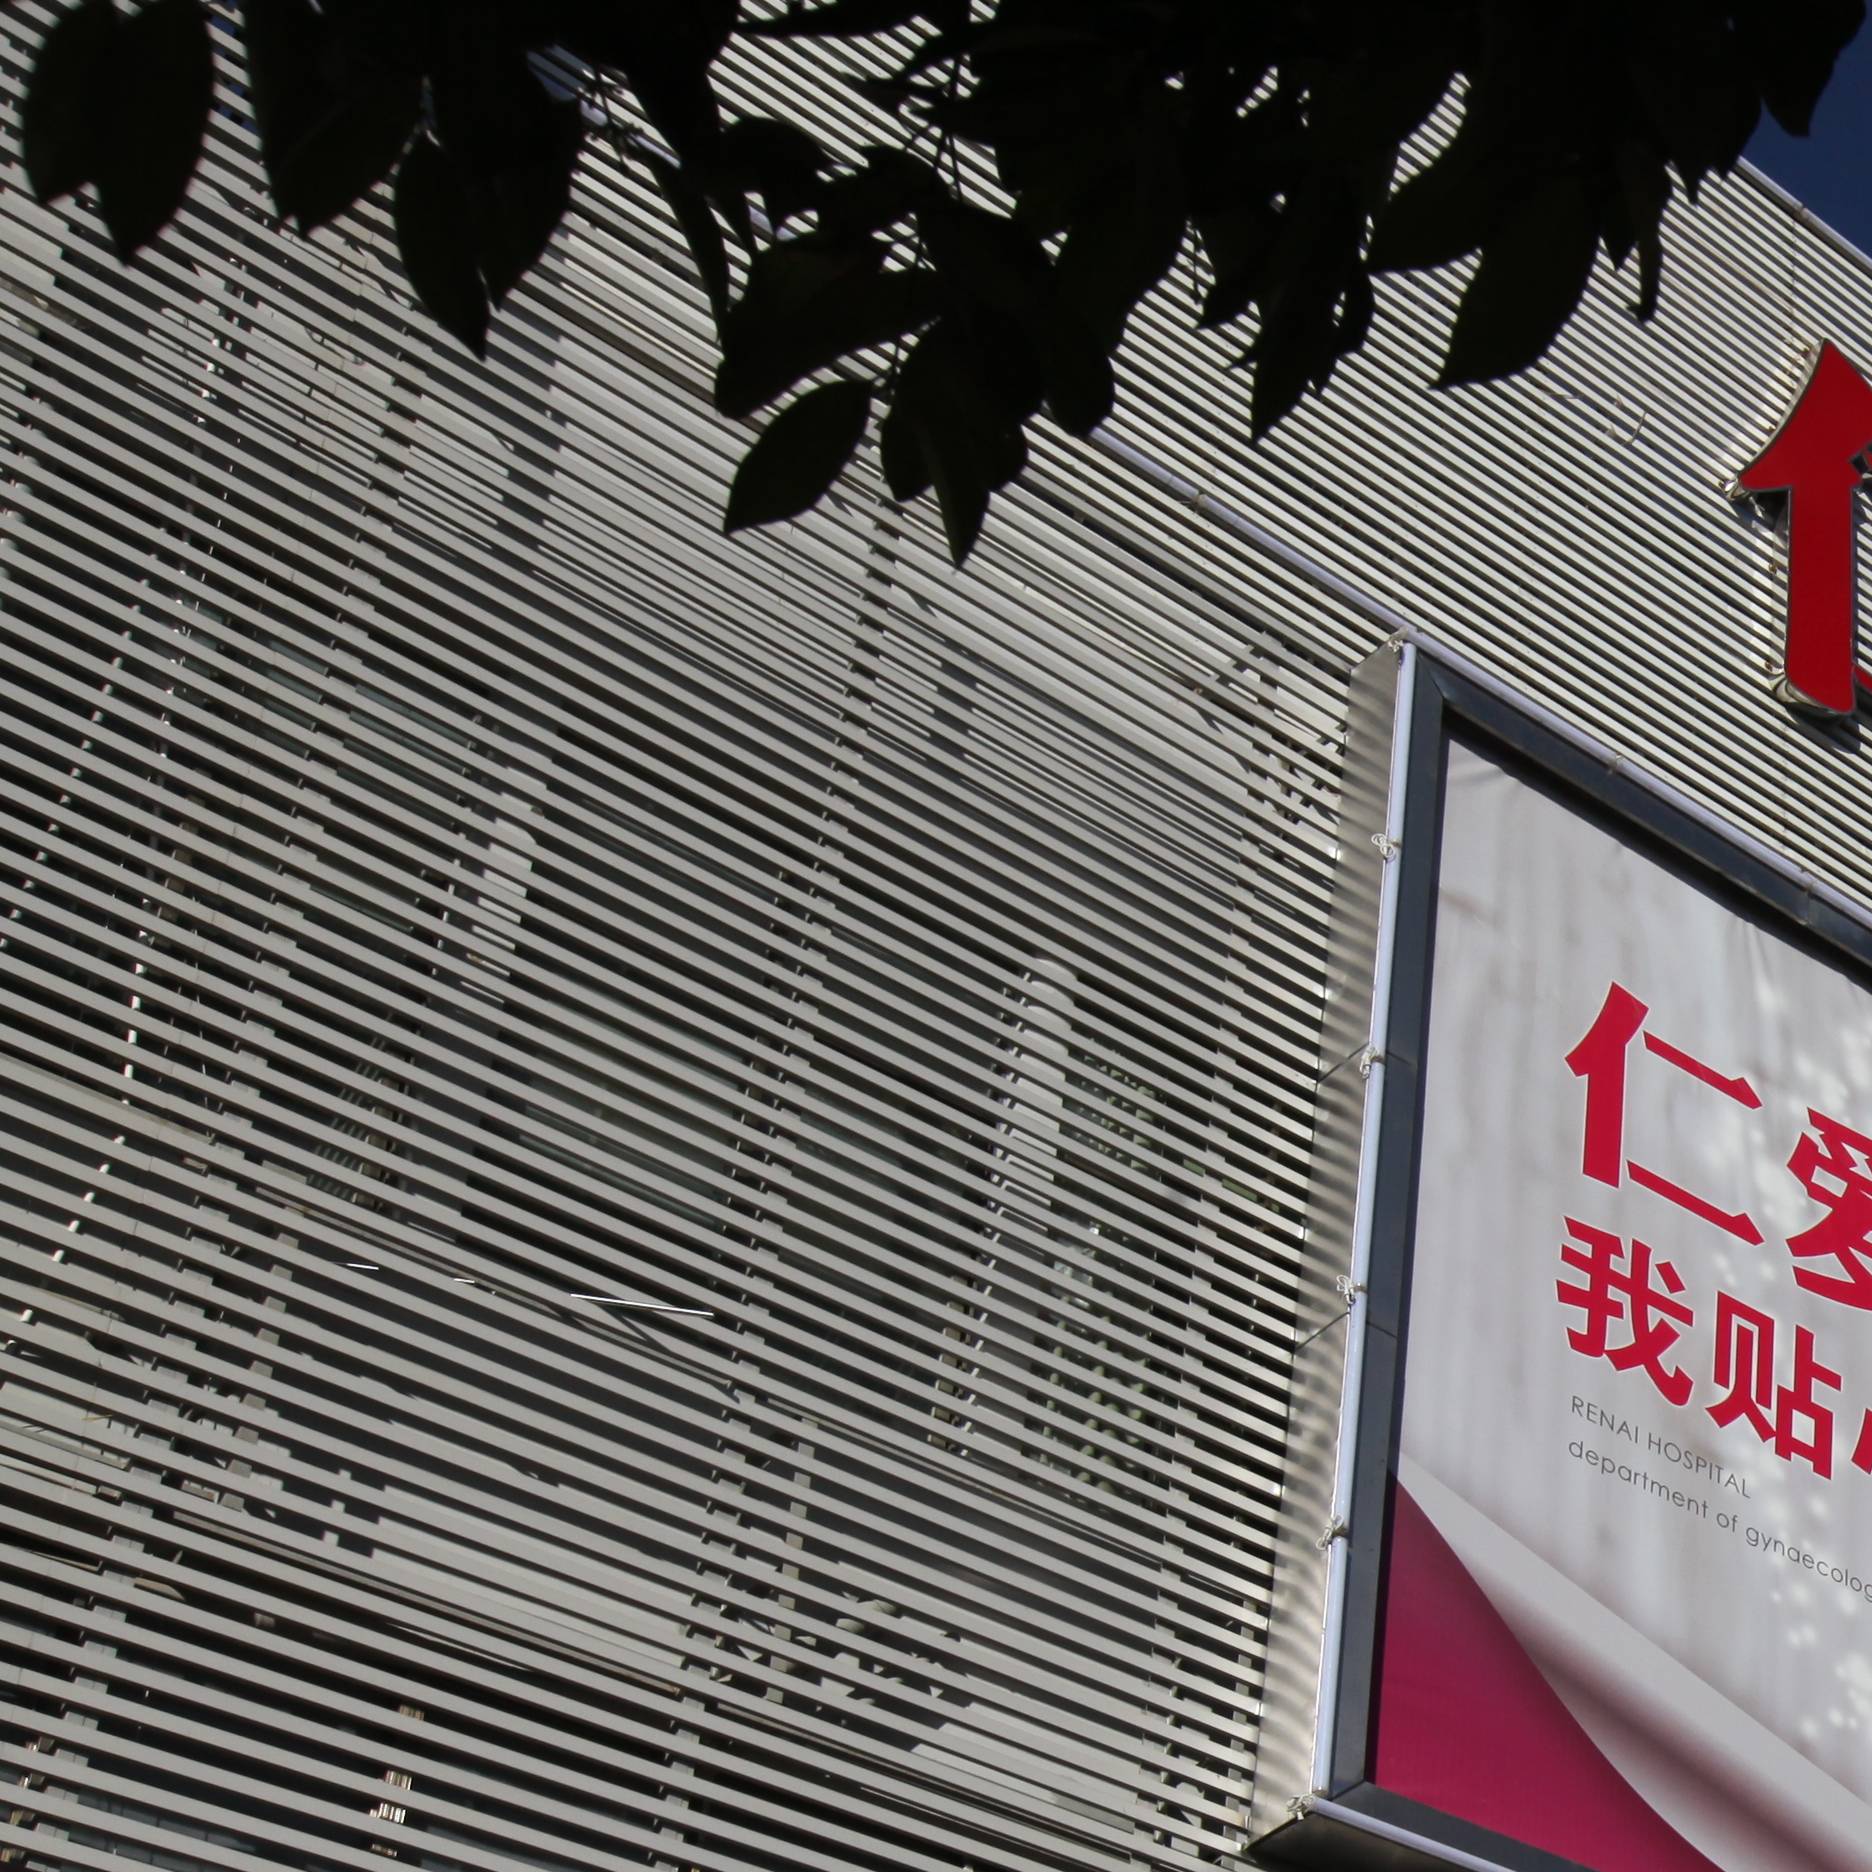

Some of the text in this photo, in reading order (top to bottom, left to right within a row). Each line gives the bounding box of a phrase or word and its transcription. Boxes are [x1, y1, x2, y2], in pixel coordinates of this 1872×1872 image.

[1568, 1440, 1709, 1520] department
[1716, 1511, 1739, 1533] of
[1571, 1395, 1751, 1499] RENAI HOSPITAL
